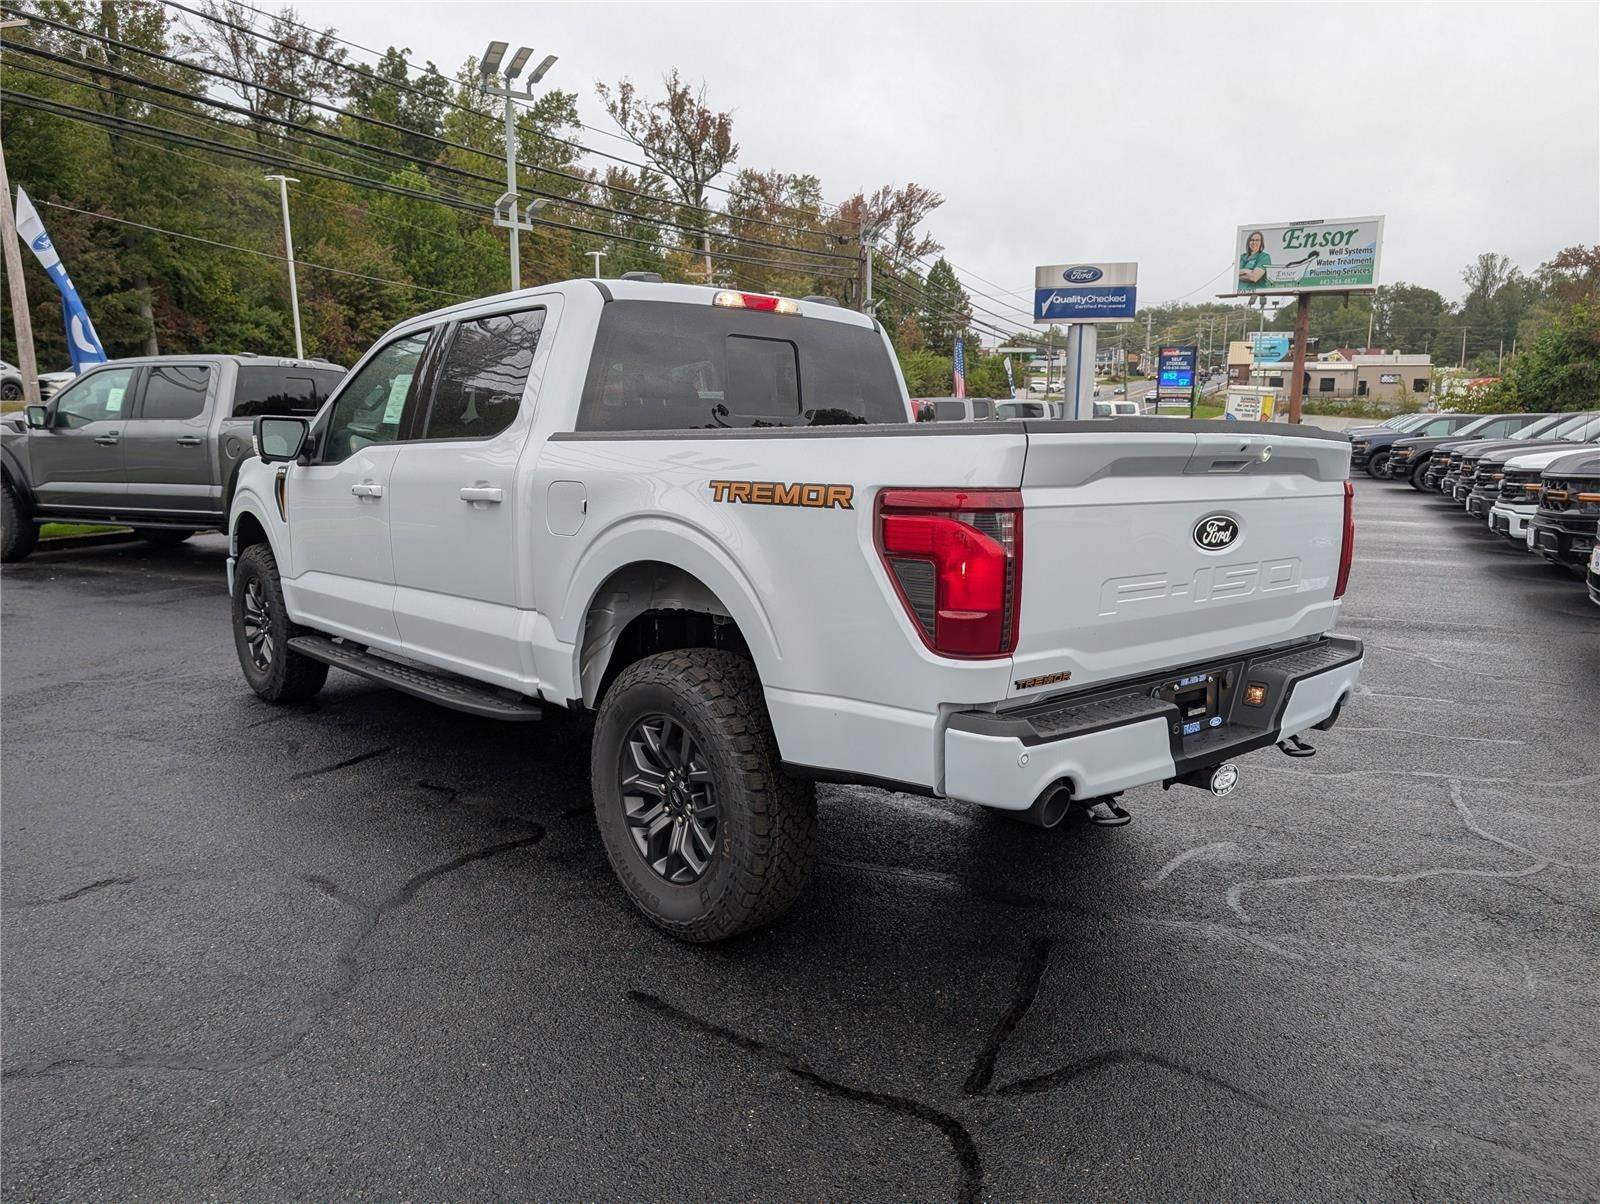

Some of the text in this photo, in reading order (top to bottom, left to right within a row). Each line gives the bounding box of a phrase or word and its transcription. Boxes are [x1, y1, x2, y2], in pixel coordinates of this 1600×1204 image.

[1282, 228, 1359, 250] Ensor
[1316, 257, 1372, 266] Water Treatment
[1329, 247, 1373, 256] Well Systems
[1070, 269, 1093, 280] Ford
[1309, 267, 1371, 277] Plumbing Services
[709, 480, 855, 510] TREMOR
[1203, 519, 1233, 544] Ford
[1098, 556, 1302, 616] F-150
[1014, 669, 1072, 691] TREMOR
